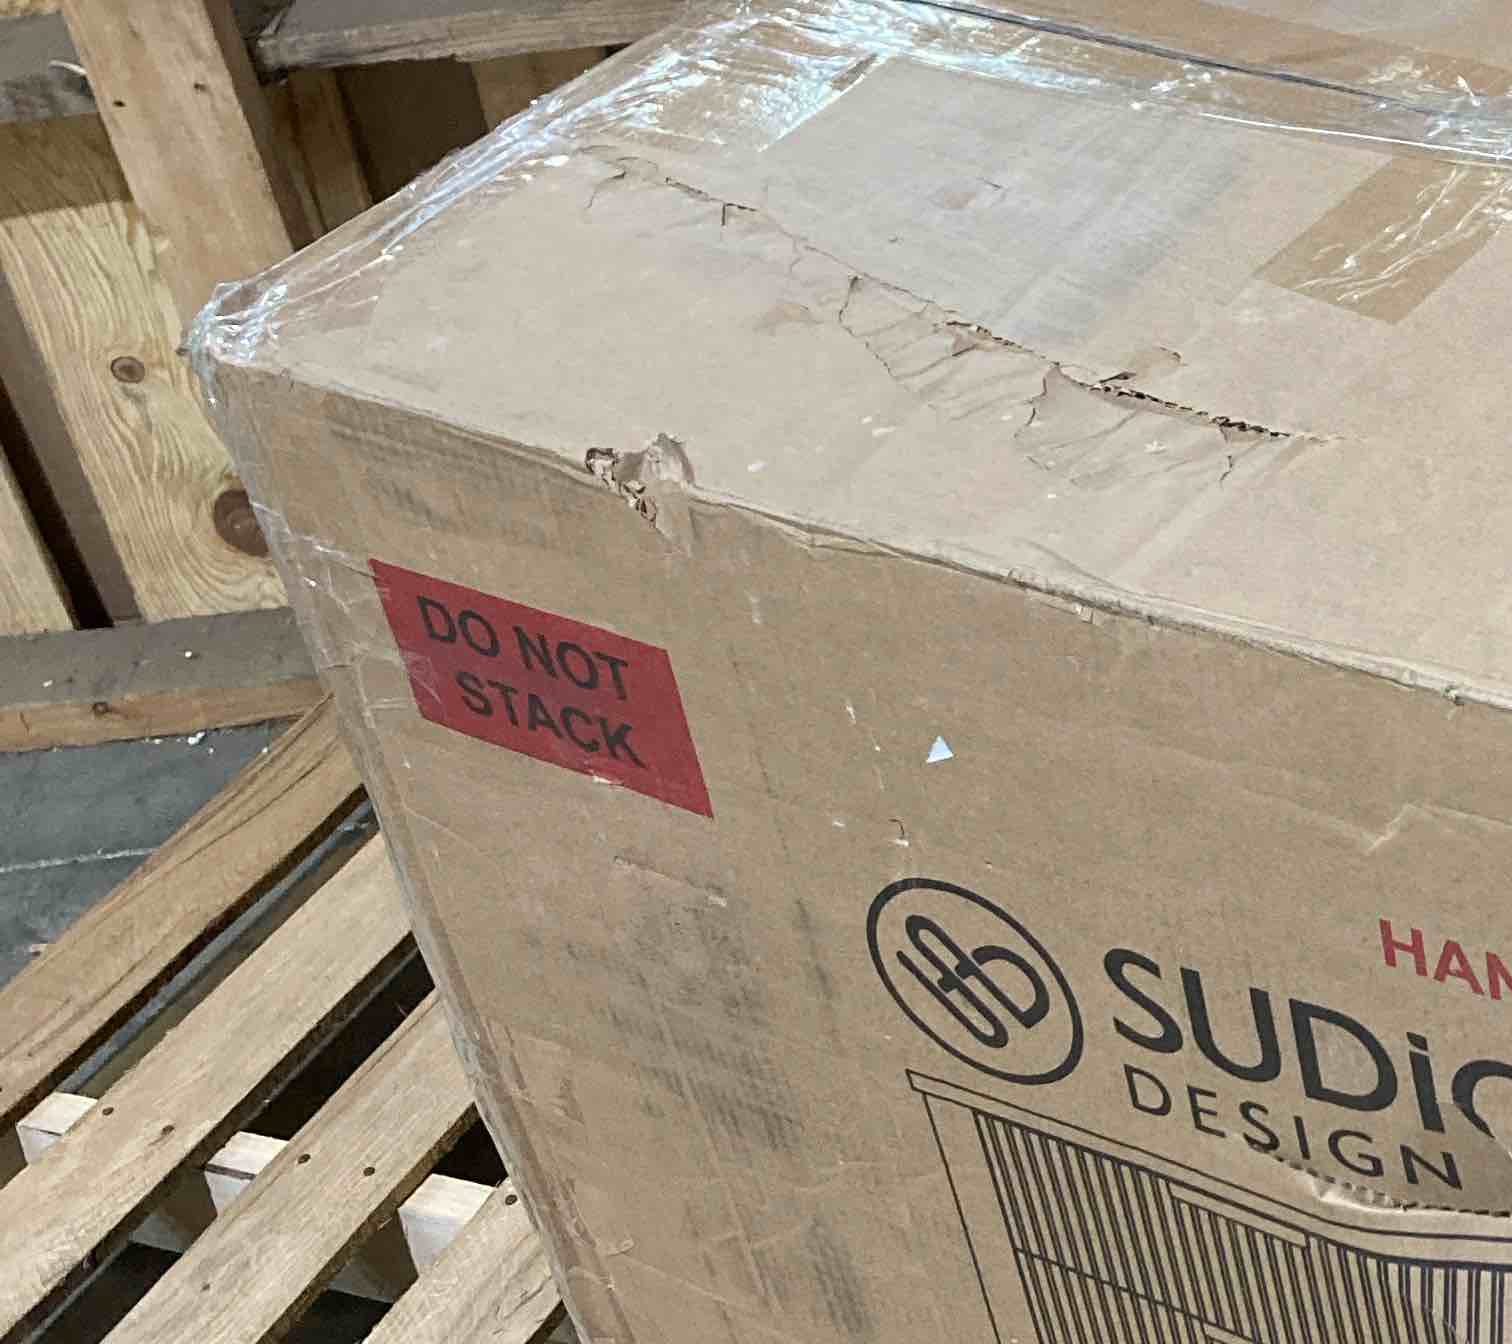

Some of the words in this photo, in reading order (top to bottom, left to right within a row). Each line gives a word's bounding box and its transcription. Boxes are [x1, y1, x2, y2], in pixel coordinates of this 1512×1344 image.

[417, 596, 499, 657] DO
[514, 626, 628, 701] NOT
[456, 671, 647, 768] STACK
[1124, 1064, 1464, 1191] DESIGN
